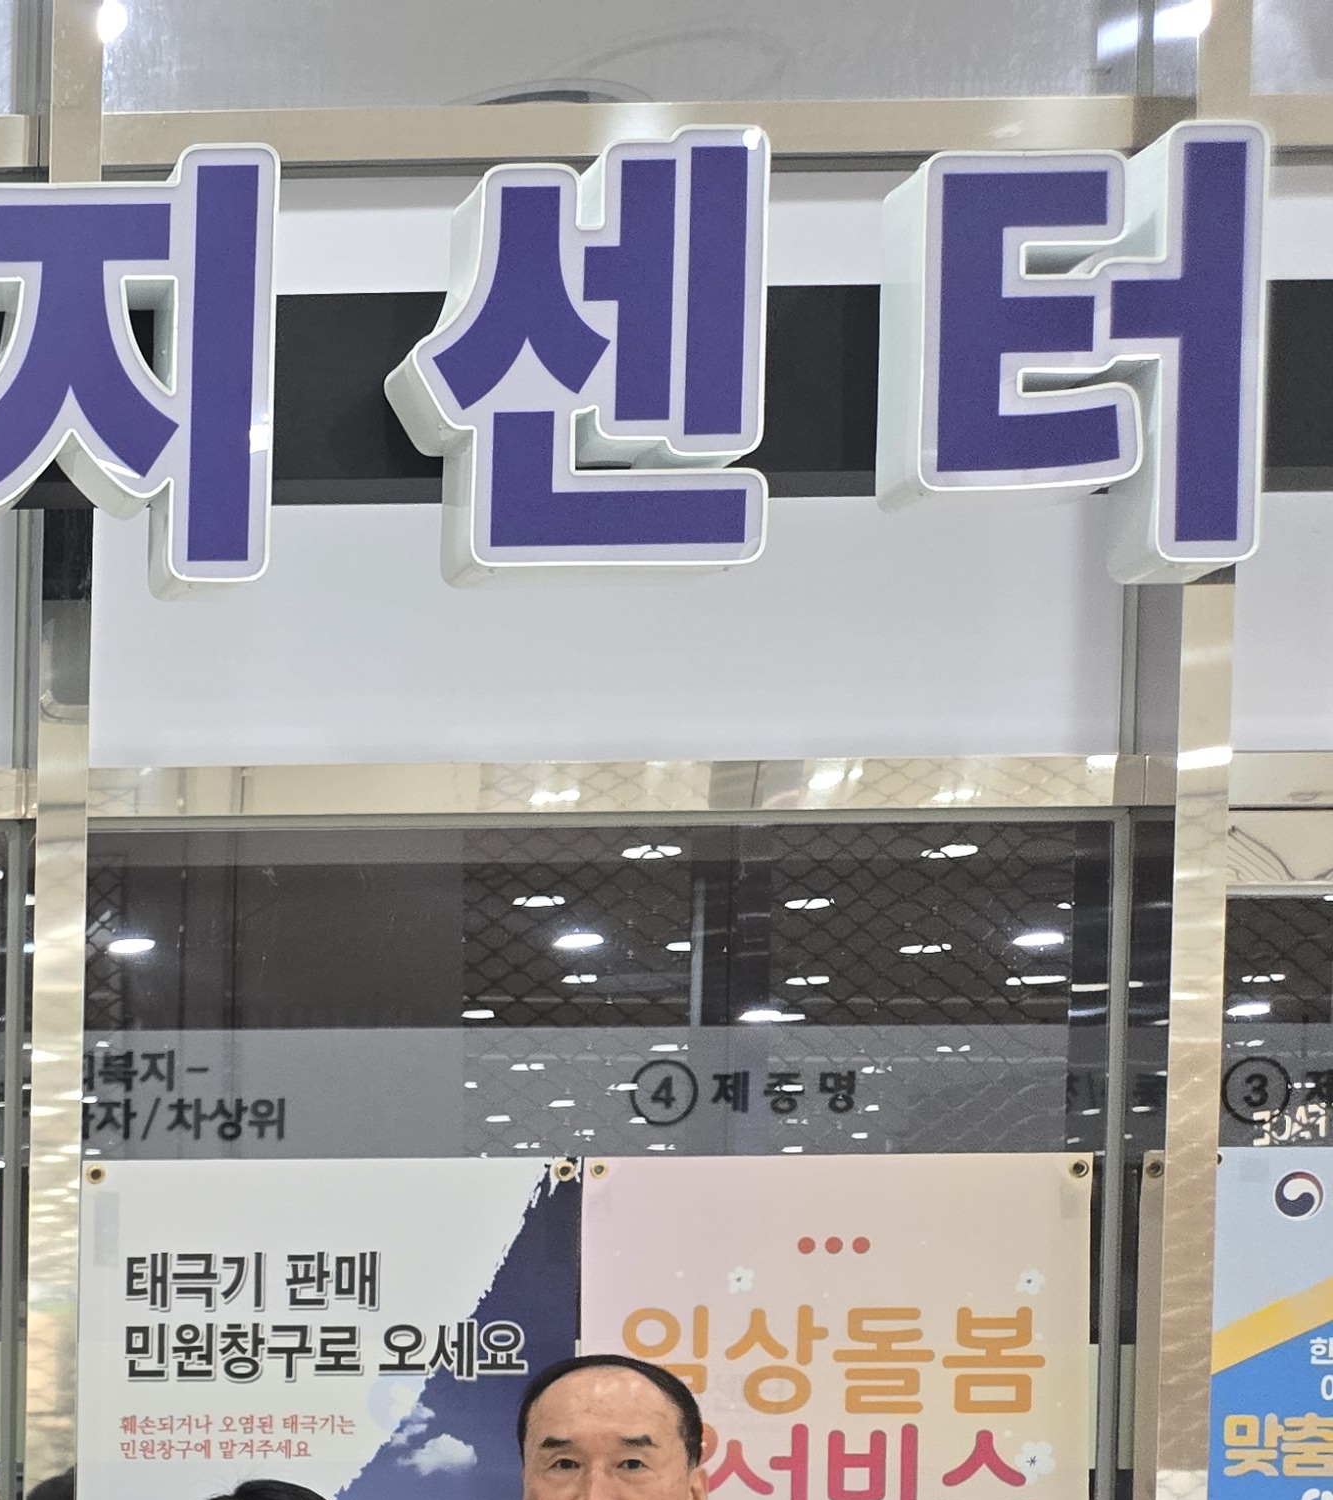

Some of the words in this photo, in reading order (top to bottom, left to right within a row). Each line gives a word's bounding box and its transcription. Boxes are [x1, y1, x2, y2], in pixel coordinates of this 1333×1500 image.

[125, 1252, 267, 1311] 태극기
[286, 1251, 381, 1309] 판매
[124, 1321, 363, 1381] 민원창구로
[378, 1320, 528, 1380] 오세요
[621, 1304, 1047, 1415] 일상돌봄
[120, 1415, 212, 1436] 훼손되거나
[218, 1415, 274, 1436] 오염된
[283, 1415, 356, 1436] 태극기는
[120, 1440, 212, 1460] 민원창구에
[218, 1440, 312, 1460] 맡겨주세요
